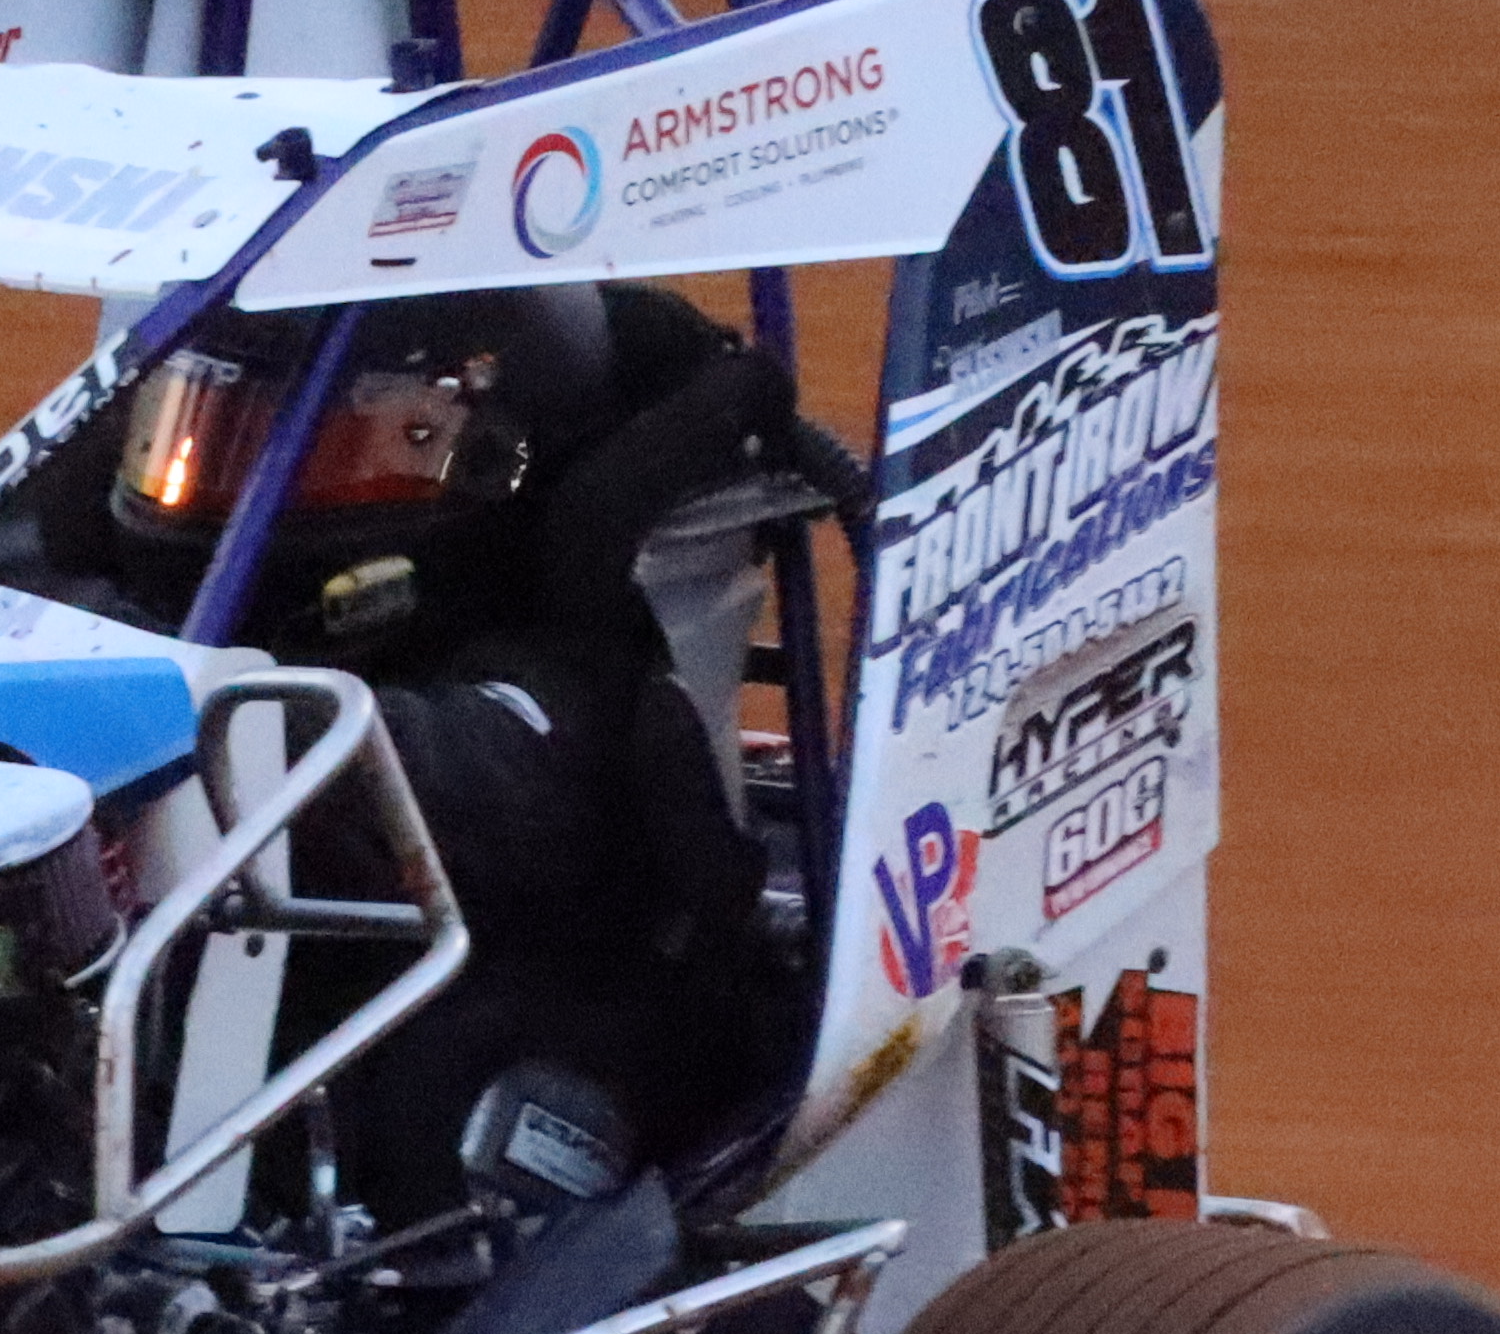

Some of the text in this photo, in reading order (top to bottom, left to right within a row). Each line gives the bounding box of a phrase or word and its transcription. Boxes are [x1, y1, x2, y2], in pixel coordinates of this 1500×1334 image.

[622, 47, 884, 161] ARMSTRONG
[622, 152, 742, 206] COMFORT
[868, 422, 1068, 647] FRONT
[987, 619, 1195, 799] HYPER
[872, 800, 957, 999] VP
